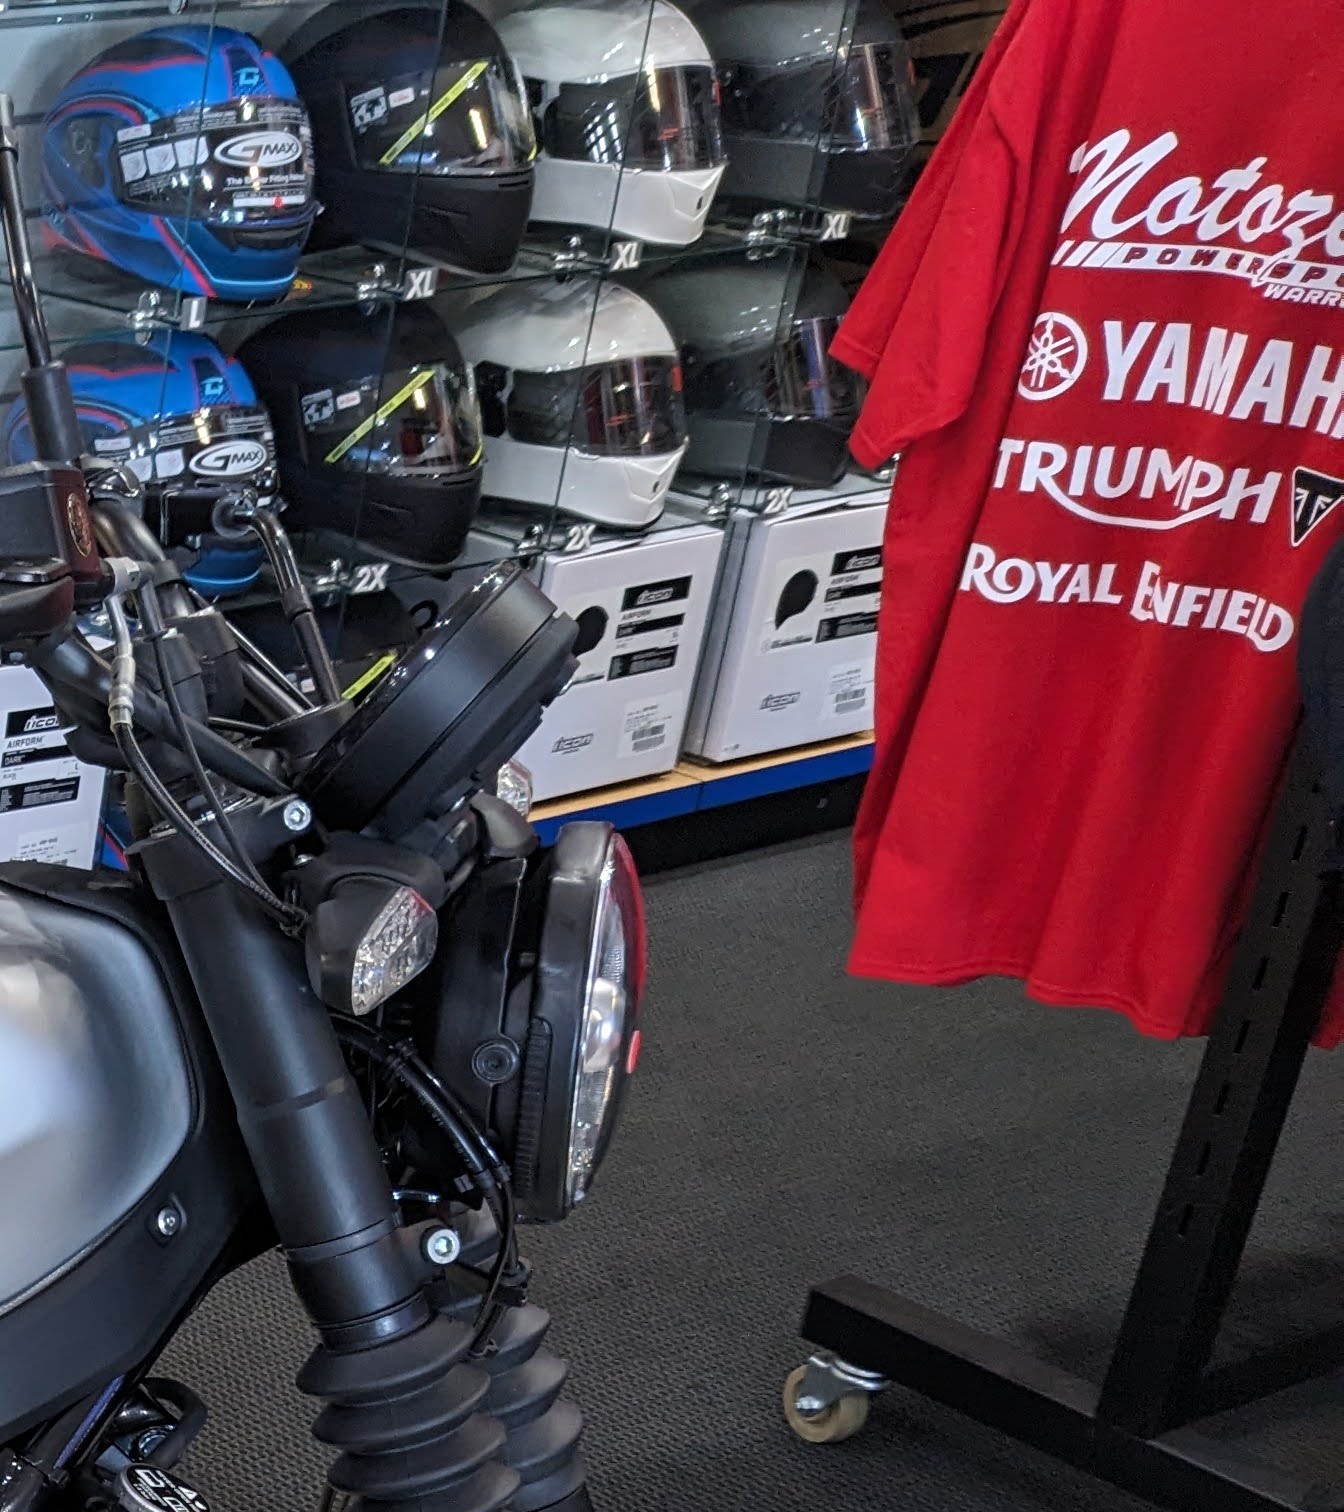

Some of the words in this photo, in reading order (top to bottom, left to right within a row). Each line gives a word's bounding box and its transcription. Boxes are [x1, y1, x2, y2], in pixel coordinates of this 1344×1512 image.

[822, 213, 849, 241] XL
[611, 241, 640, 271] XL
[406, 269, 436, 299] XL
[1263, 282, 1344, 309] WARR
[1102, 319, 1344, 440] YAMAH
[992, 437, 1284, 531] TRIUMPH
[764, 487, 793, 514] 2X
[565, 523, 597, 551] 2X
[353, 563, 390, 594] 2X
[959, 542, 1123, 604] ROYAL
[1130, 560, 1296, 652] ENFIELD
[23, 716, 60, 732] ico
